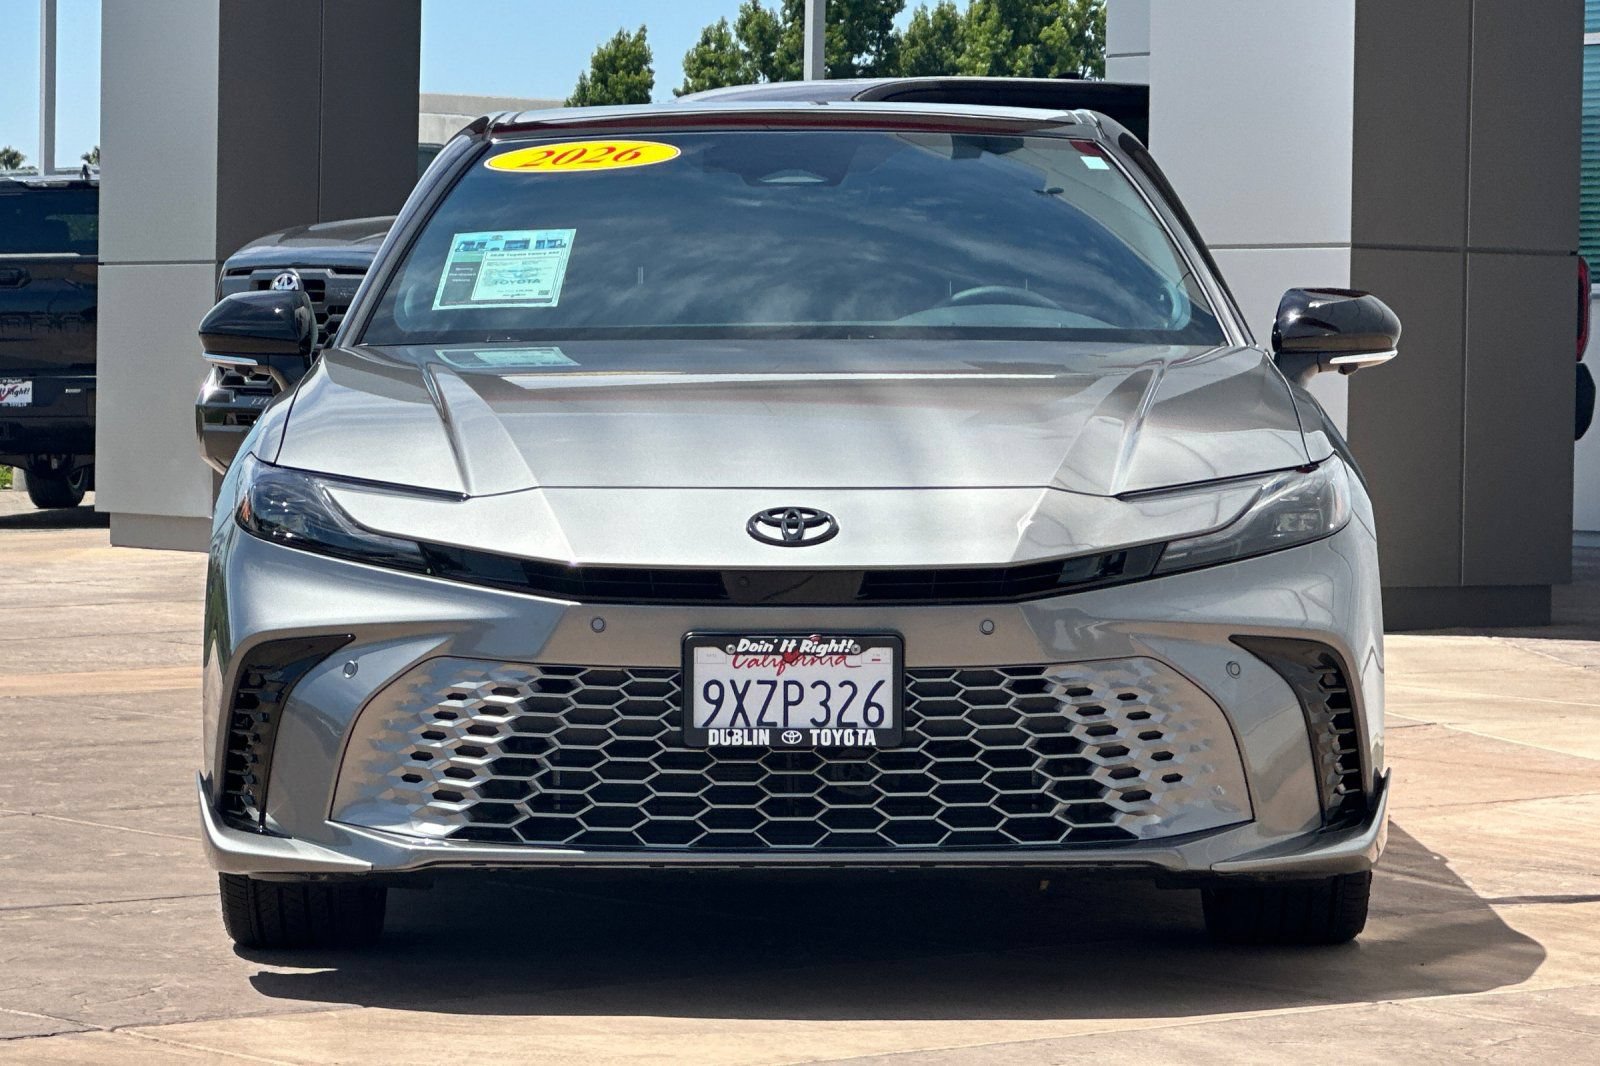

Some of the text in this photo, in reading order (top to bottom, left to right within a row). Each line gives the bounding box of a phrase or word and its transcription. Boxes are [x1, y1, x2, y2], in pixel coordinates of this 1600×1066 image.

[516, 145, 650, 168] 2026
[736, 638, 855, 657] Doin' It Right!
[732, 653, 862, 677] California
[702, 678, 886, 728] 9XZP326
[708, 728, 877, 746] DUBLIN TOYOTA
